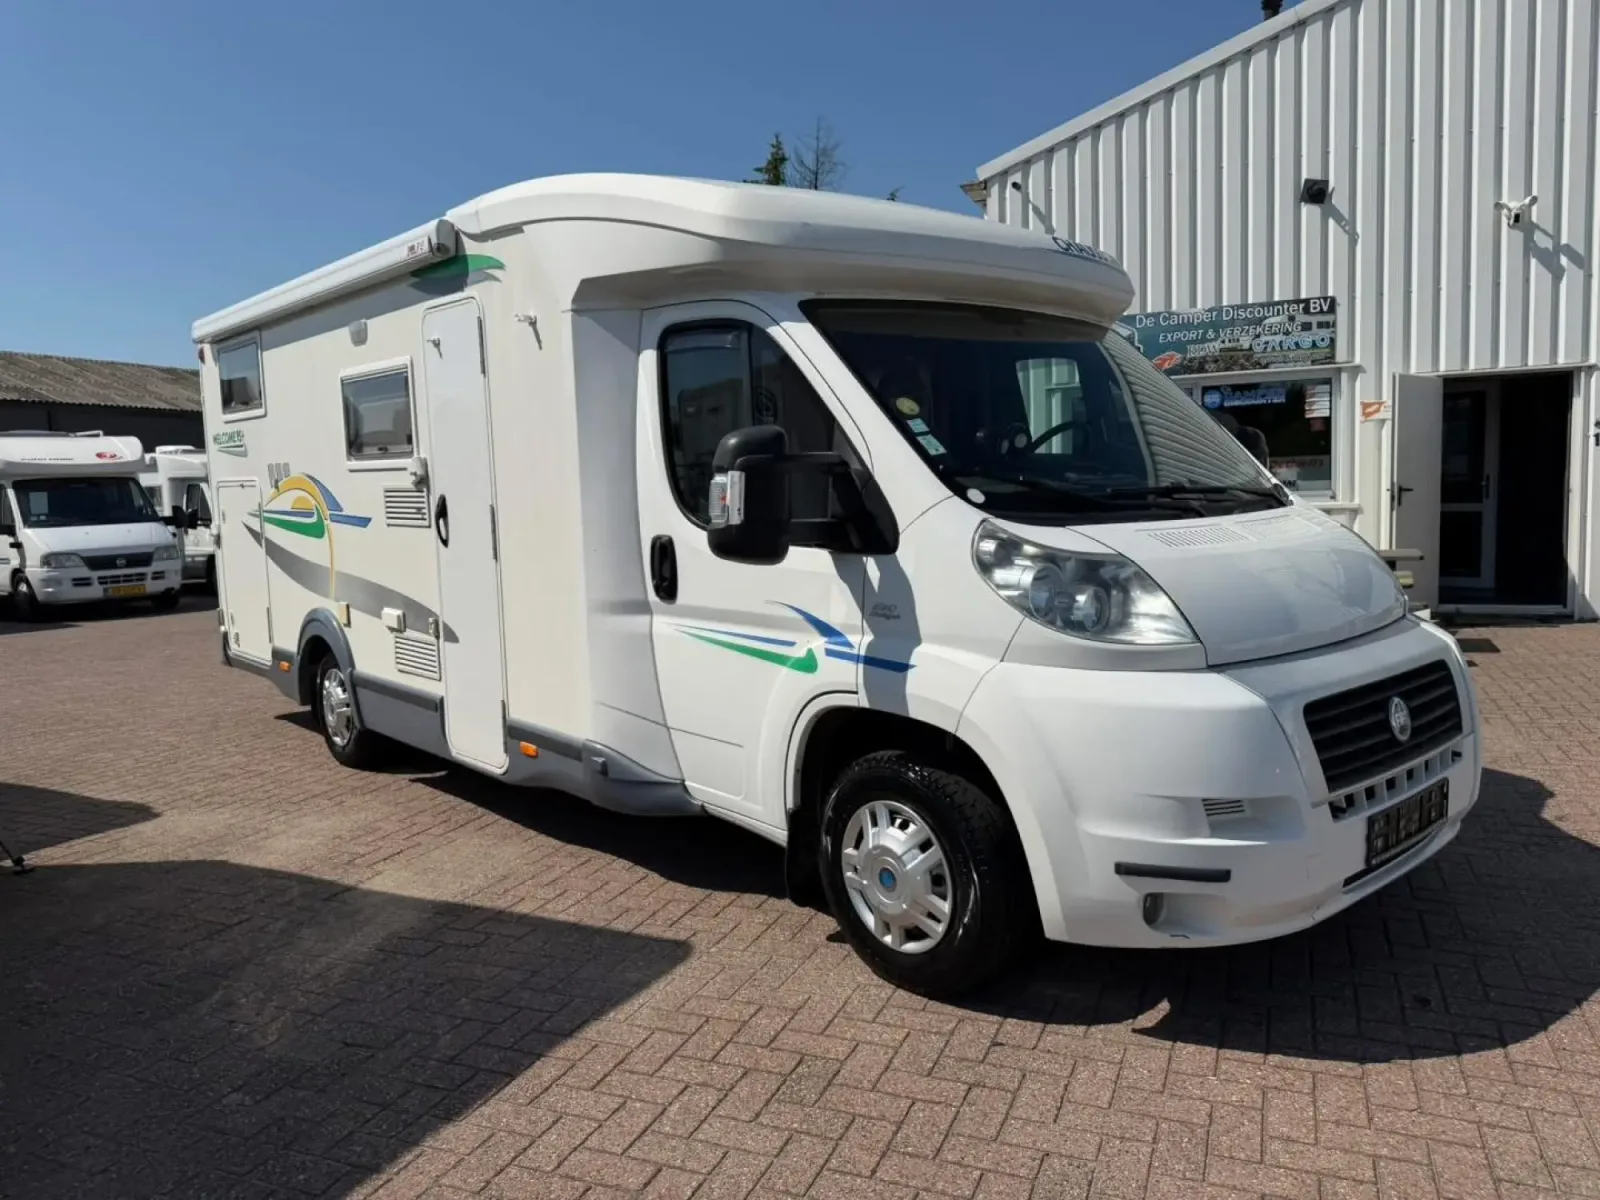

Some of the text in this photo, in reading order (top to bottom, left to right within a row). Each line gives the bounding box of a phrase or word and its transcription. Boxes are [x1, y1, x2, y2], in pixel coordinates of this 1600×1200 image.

[1136, 298, 1331, 328] De Camper Discounter BV
[1159, 321, 1302, 343] EXPORT & VERZEKERING
